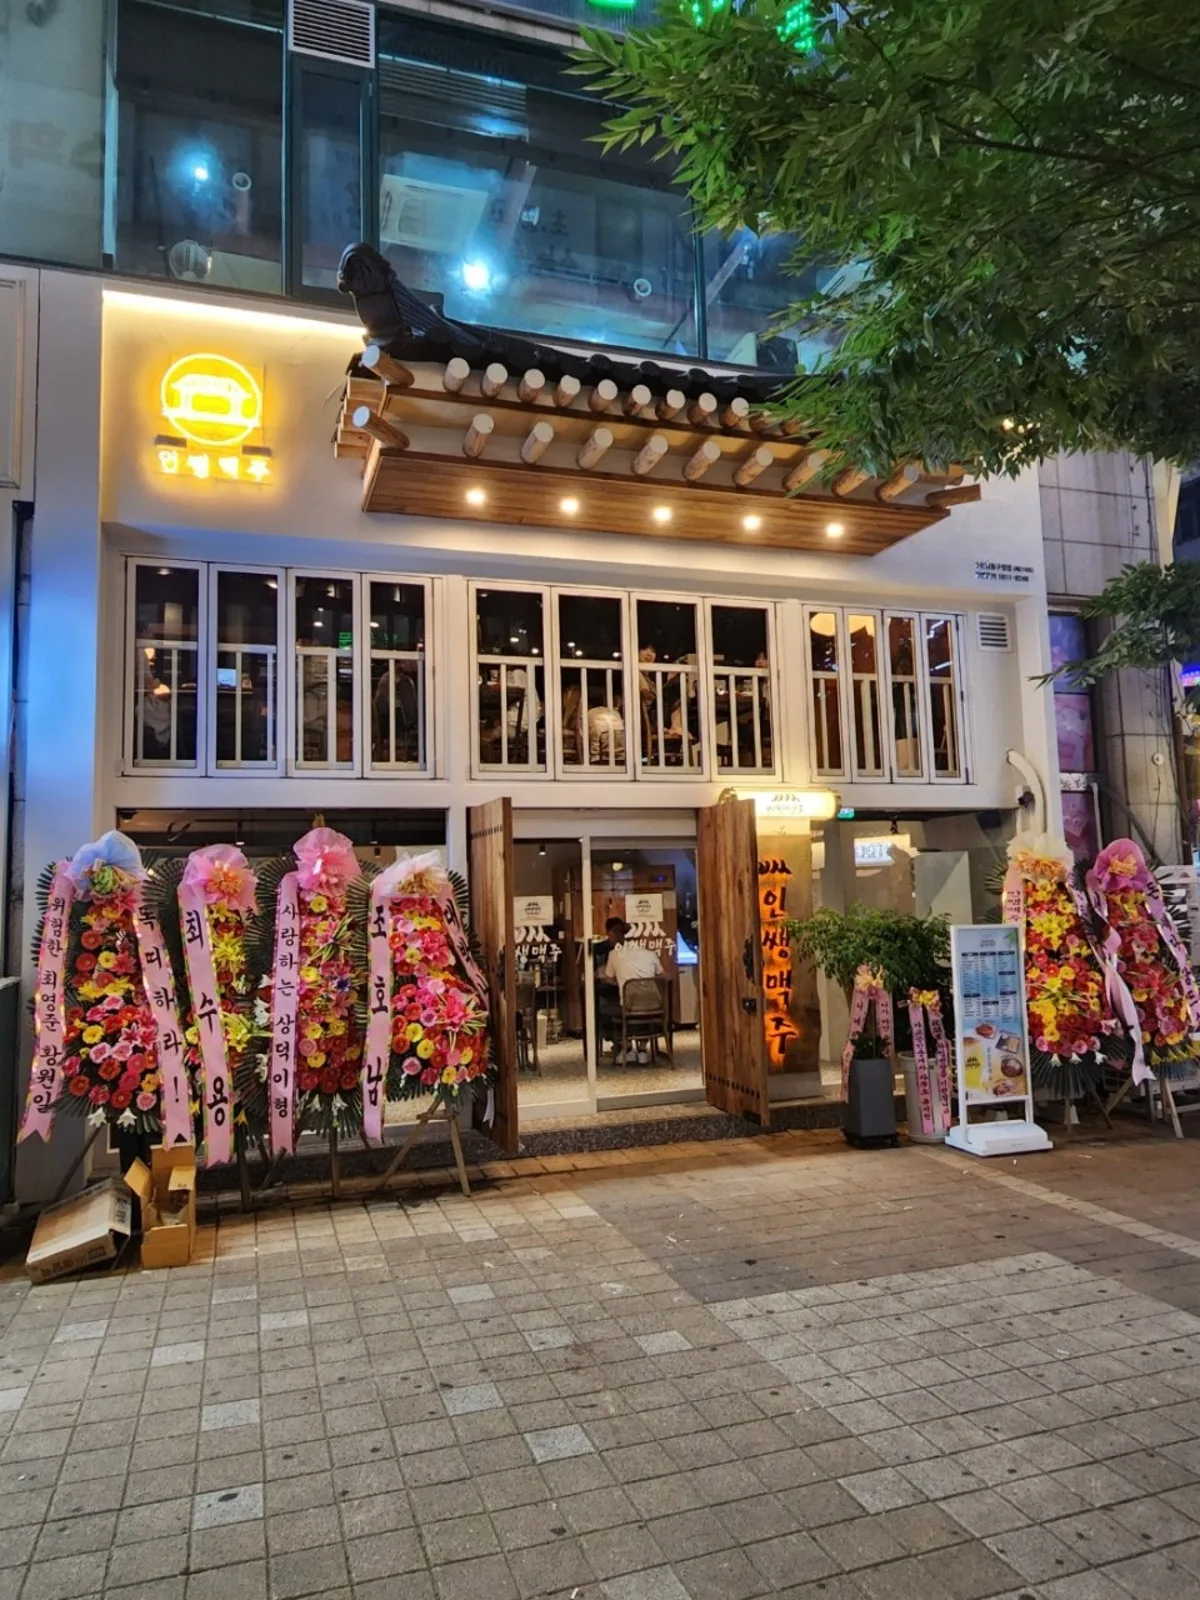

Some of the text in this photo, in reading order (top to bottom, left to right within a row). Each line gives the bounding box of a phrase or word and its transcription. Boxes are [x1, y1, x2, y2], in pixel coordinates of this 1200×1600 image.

[33, 897, 66, 1114] 위험한 최영준 황원일
[185, 908, 231, 1126] 최수용
[273, 902, 299, 1118] 사랑하는 상덕이형
[364, 905, 390, 1107] 조호남
[762, 886, 799, 1055] 인쌩맥주
